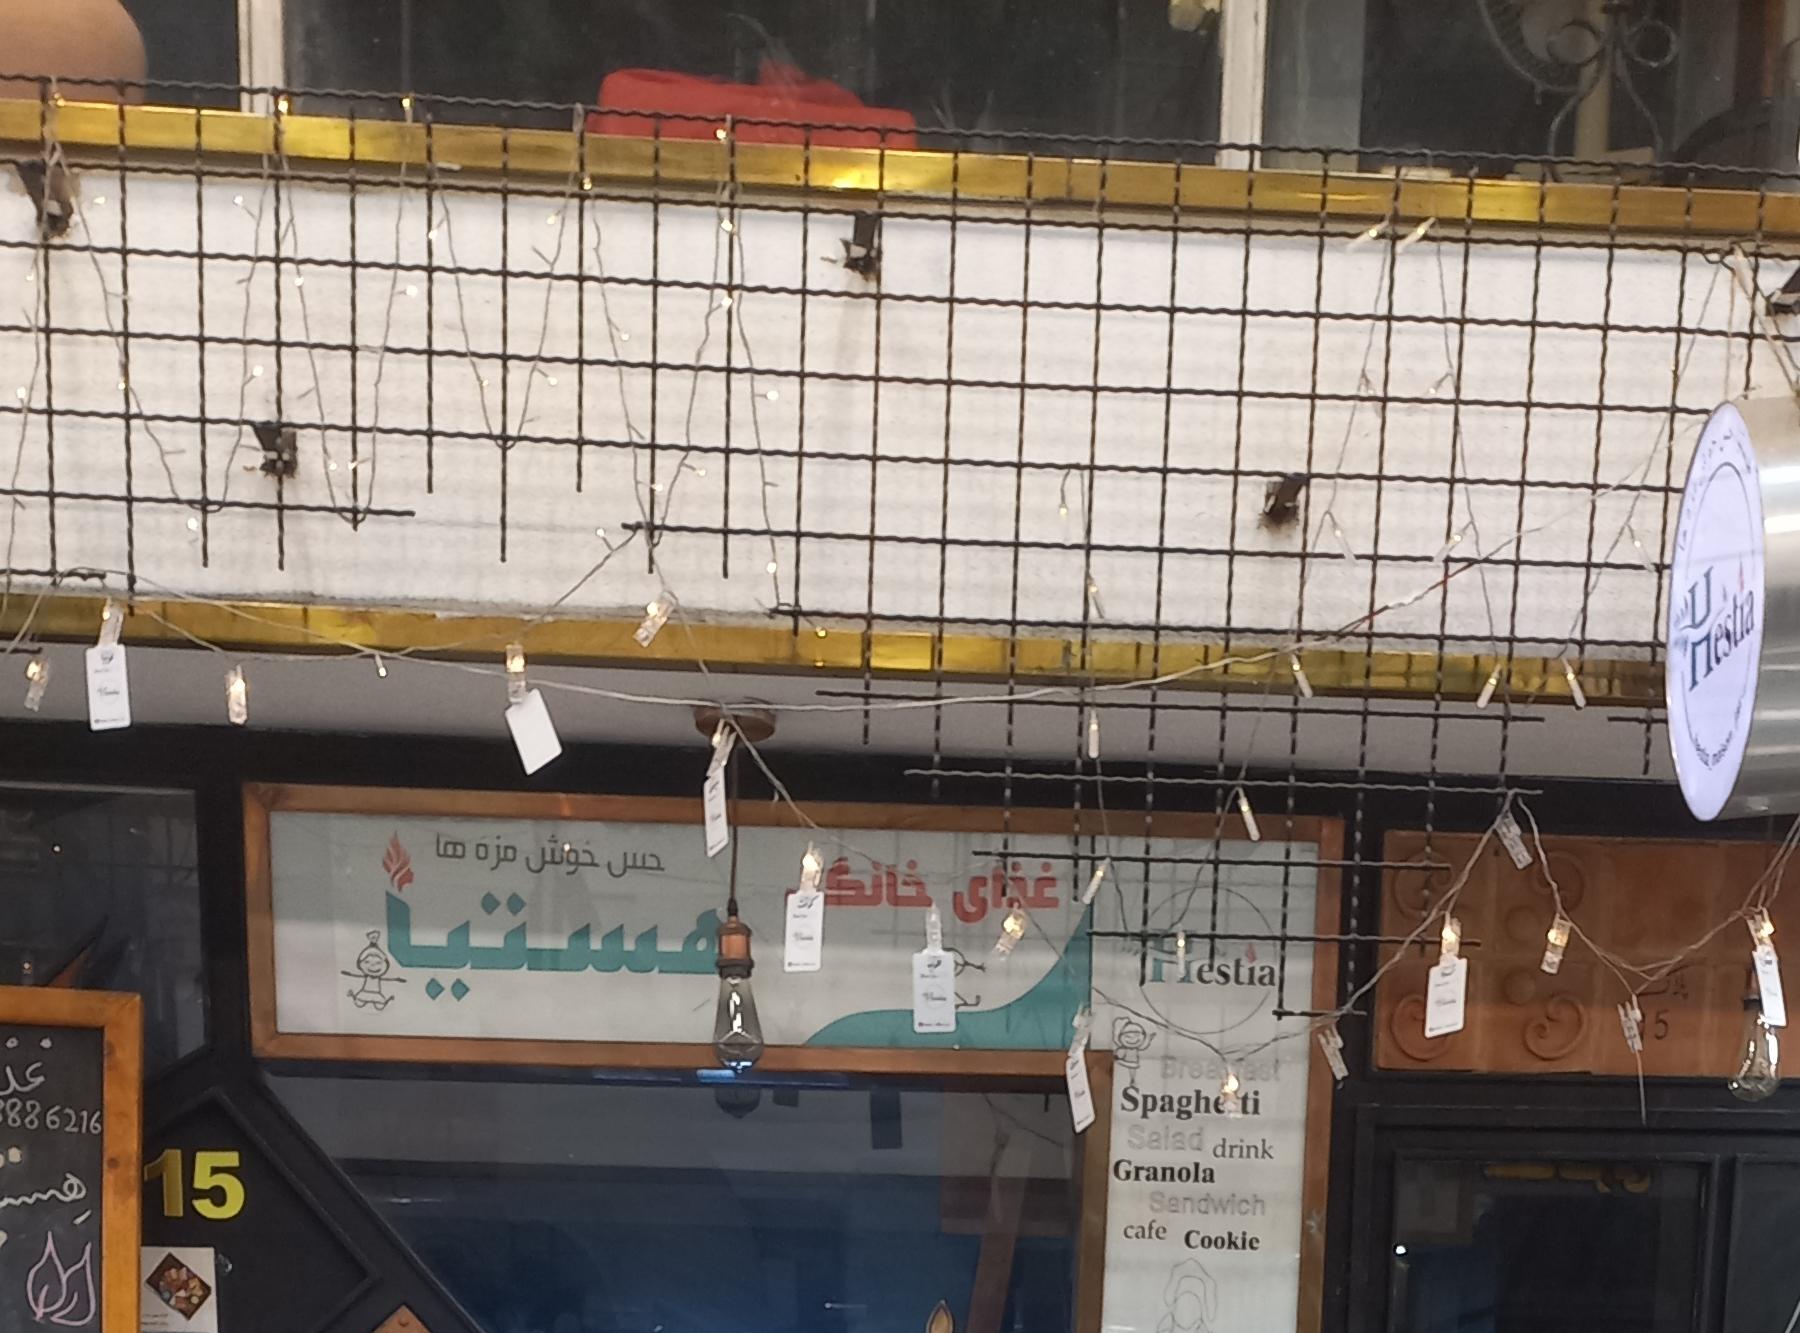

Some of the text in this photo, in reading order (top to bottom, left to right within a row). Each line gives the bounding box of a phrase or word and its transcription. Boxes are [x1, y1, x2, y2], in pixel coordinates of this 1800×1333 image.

[436, 832, 466, 859] ها
[525, 834, 600, 874] خوش
[1121, 1085, 1261, 1120] Spagheti
[1212, 1137, 1275, 1160] drink
[144, 1148, 246, 1220] 15
[1113, 1159, 1216, 1184] Granola
[1150, 1190, 1266, 1217] Sandwich
[1123, 1219, 1261, 1251] cafe Cookie
